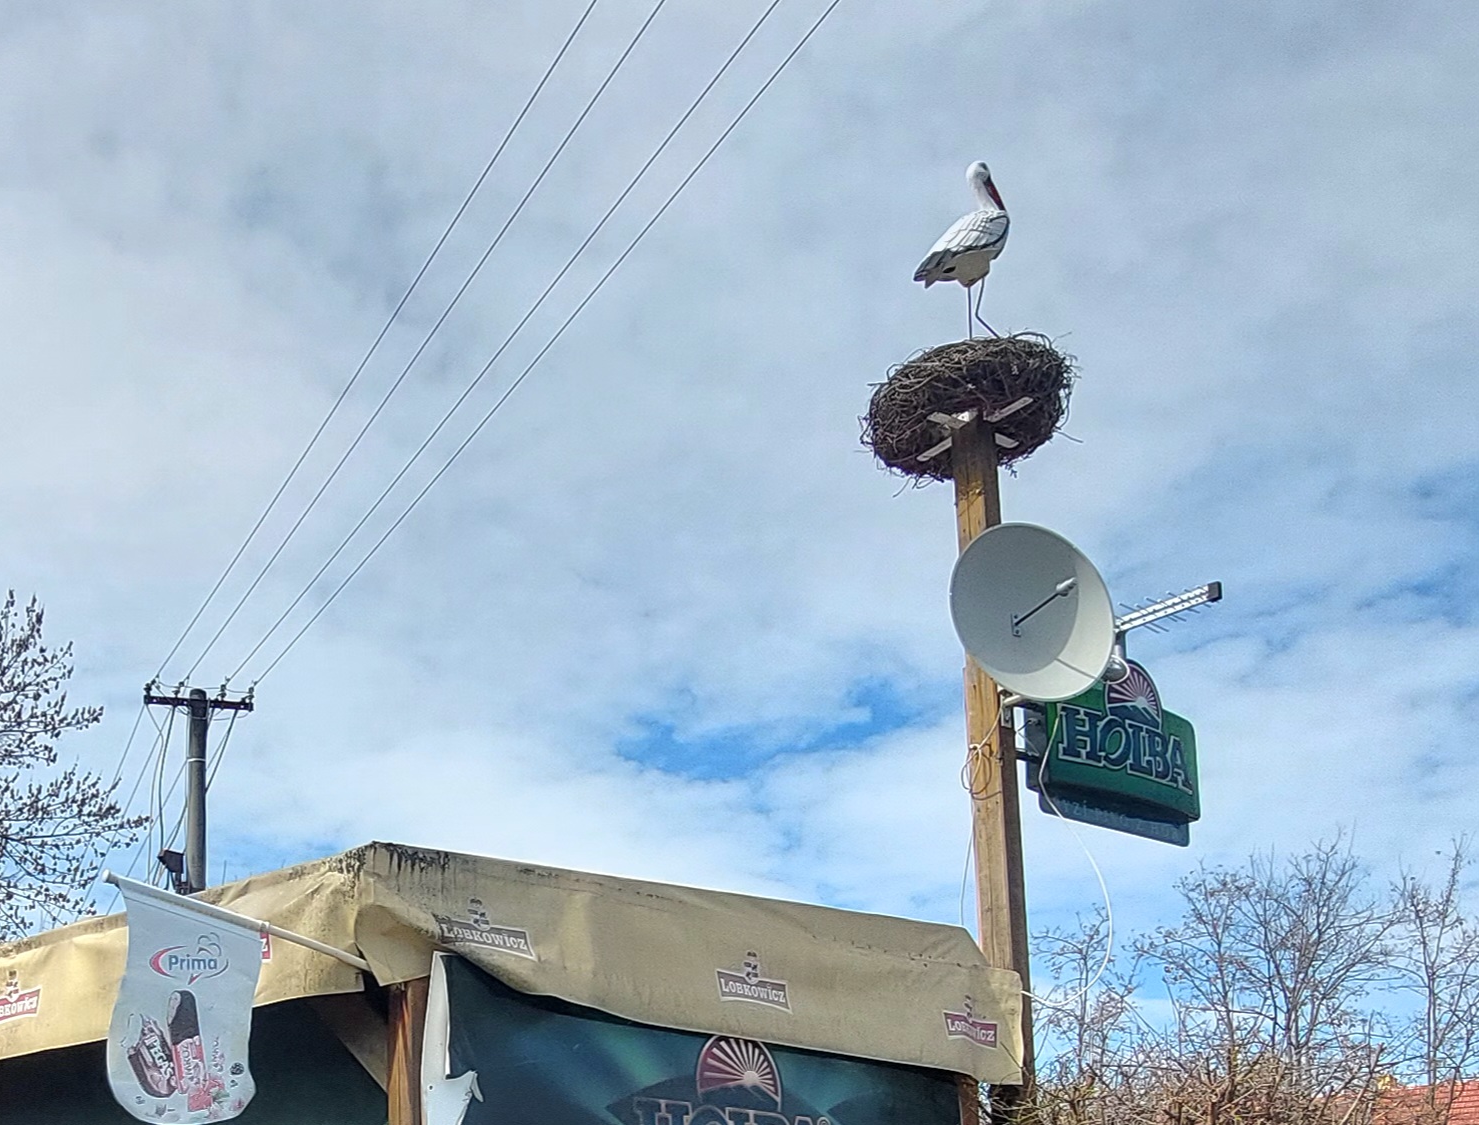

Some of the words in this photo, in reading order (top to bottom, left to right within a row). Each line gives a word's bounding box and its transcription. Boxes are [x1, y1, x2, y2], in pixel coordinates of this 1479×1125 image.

[1057, 702, 1193, 795] HOLBA
[168, 953, 218, 972] Prima
[720, 978, 786, 1003] LOBKOWICZ
